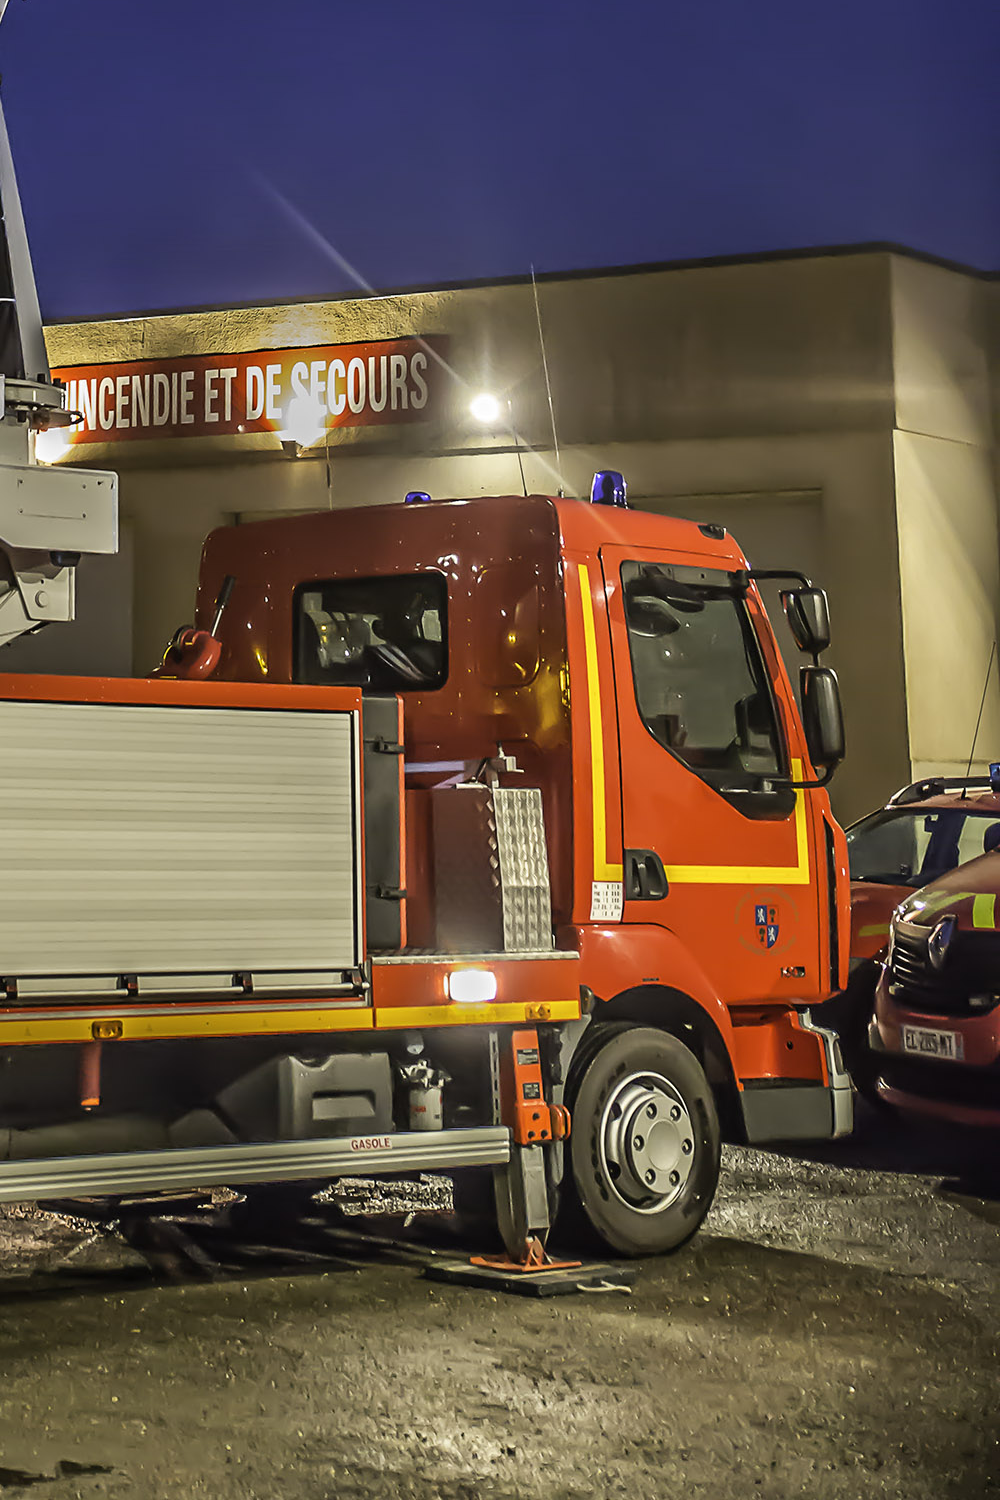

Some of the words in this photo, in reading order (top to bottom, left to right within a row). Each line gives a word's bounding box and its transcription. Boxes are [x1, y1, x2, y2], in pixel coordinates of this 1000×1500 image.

[65, 371, 195, 432] INCENDIE
[205, 367, 238, 423] ET
[246, 363, 282, 421] DE
[290, 352, 429, 417] SECOURS
